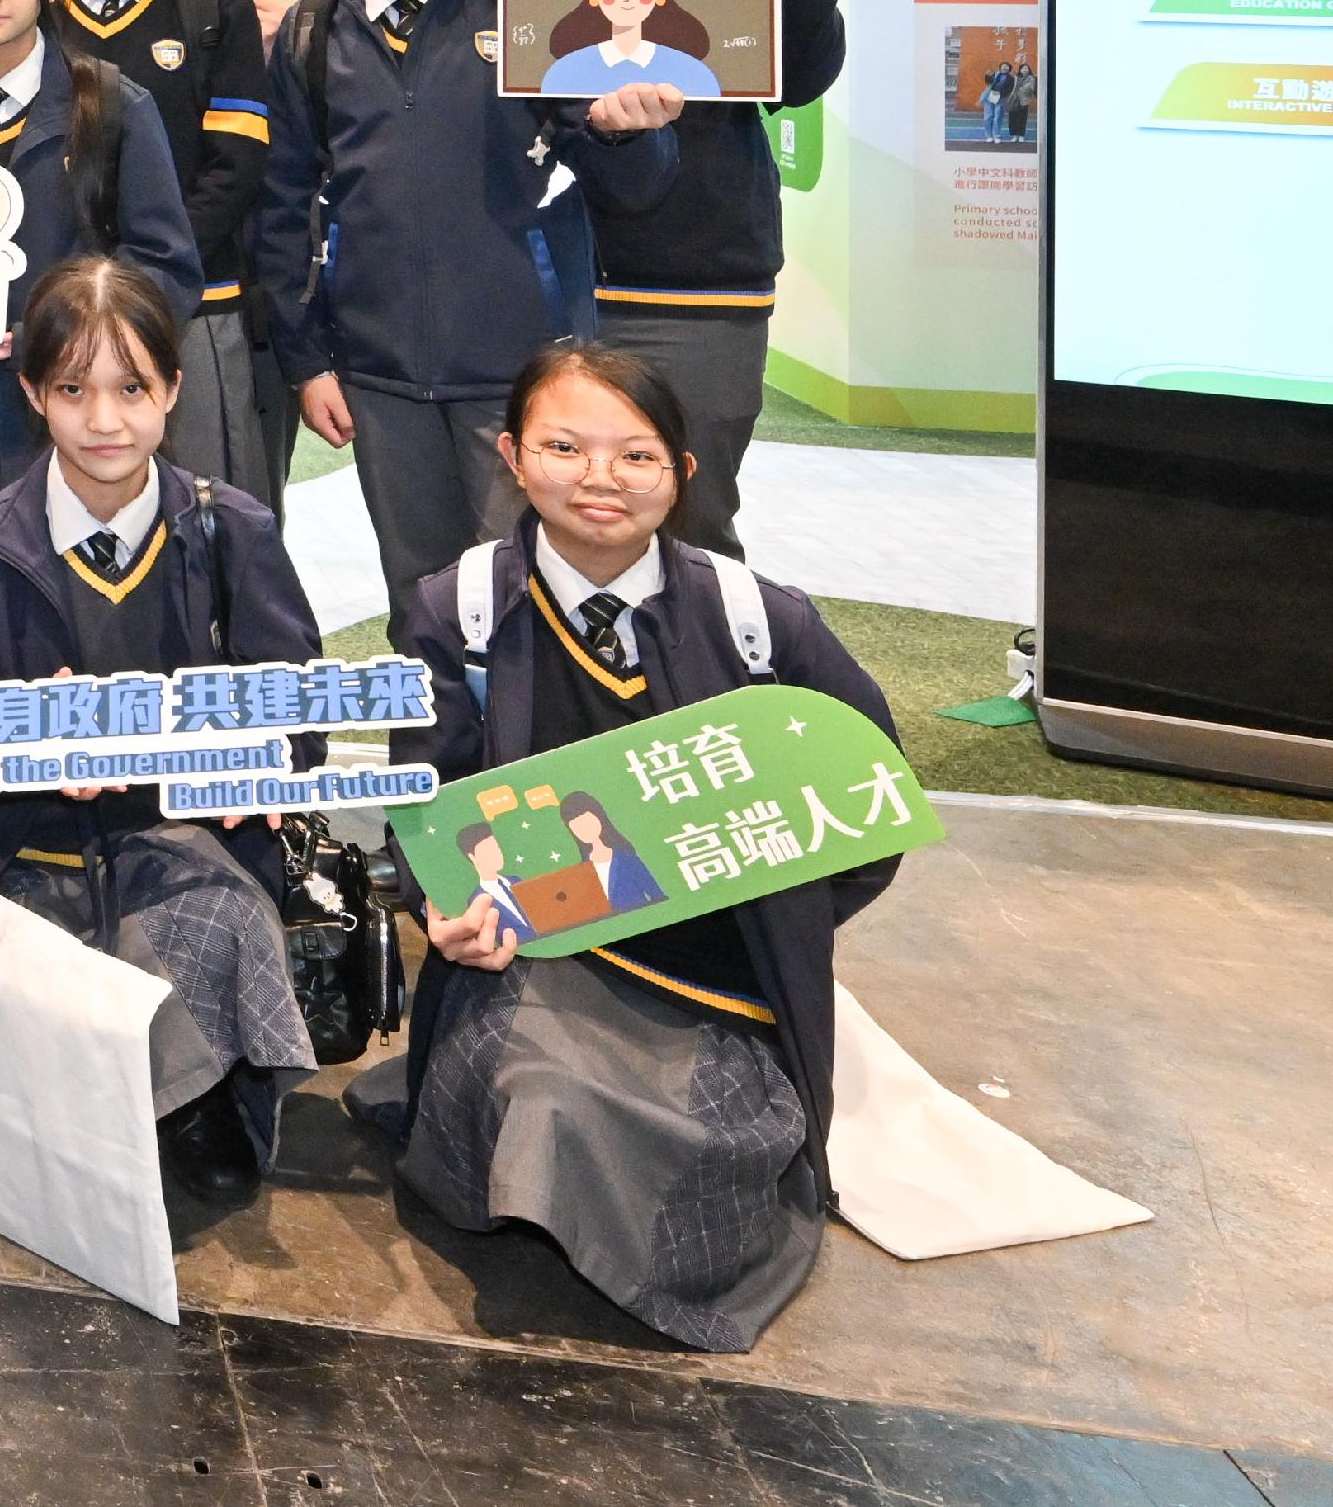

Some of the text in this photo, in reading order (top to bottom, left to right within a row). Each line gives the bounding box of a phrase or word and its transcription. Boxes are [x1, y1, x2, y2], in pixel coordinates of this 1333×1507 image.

[1227, 99, 1333, 112] INTERACTIVE
[953, 204, 1001, 217] Primary
[953, 217, 1021, 227] conducted
[953, 229, 1014, 240] shadowed
[171, 662, 428, 731] 共建未來
[2, 754, 61, 784] the
[64, 739, 286, 780] Government
[624, 722, 755, 805] 培育
[169, 769, 433, 811] Build Our Future
[663, 761, 913, 893] 高端人才
